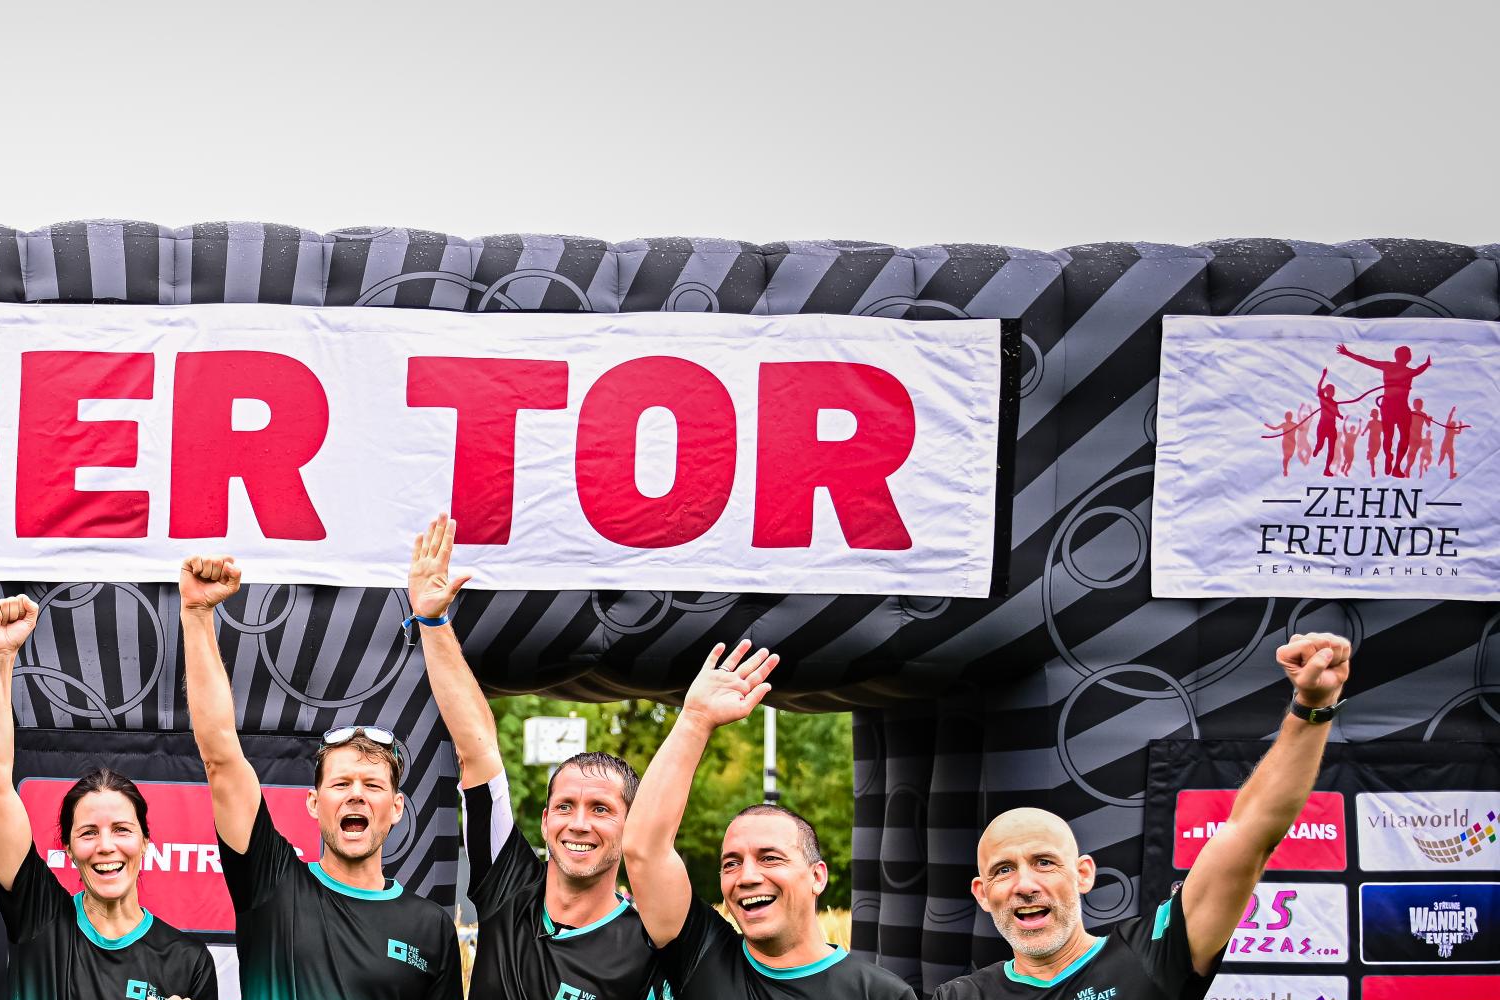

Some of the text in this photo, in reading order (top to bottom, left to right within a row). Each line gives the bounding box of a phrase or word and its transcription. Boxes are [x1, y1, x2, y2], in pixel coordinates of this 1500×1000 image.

[406, 355, 916, 550] TOR
[1303, 486, 1423, 519] ZEHN
[1256, 524, 1460, 557] FREUNDE
[1256, 564, 1459, 577] TEAM TRIATHLON
[1368, 808, 1469, 829] vitaworld
[1409, 907, 1479, 934] WANDER
[1425, 932, 1464, 945] EVENT
[1077, 986, 1095, 999] WE
